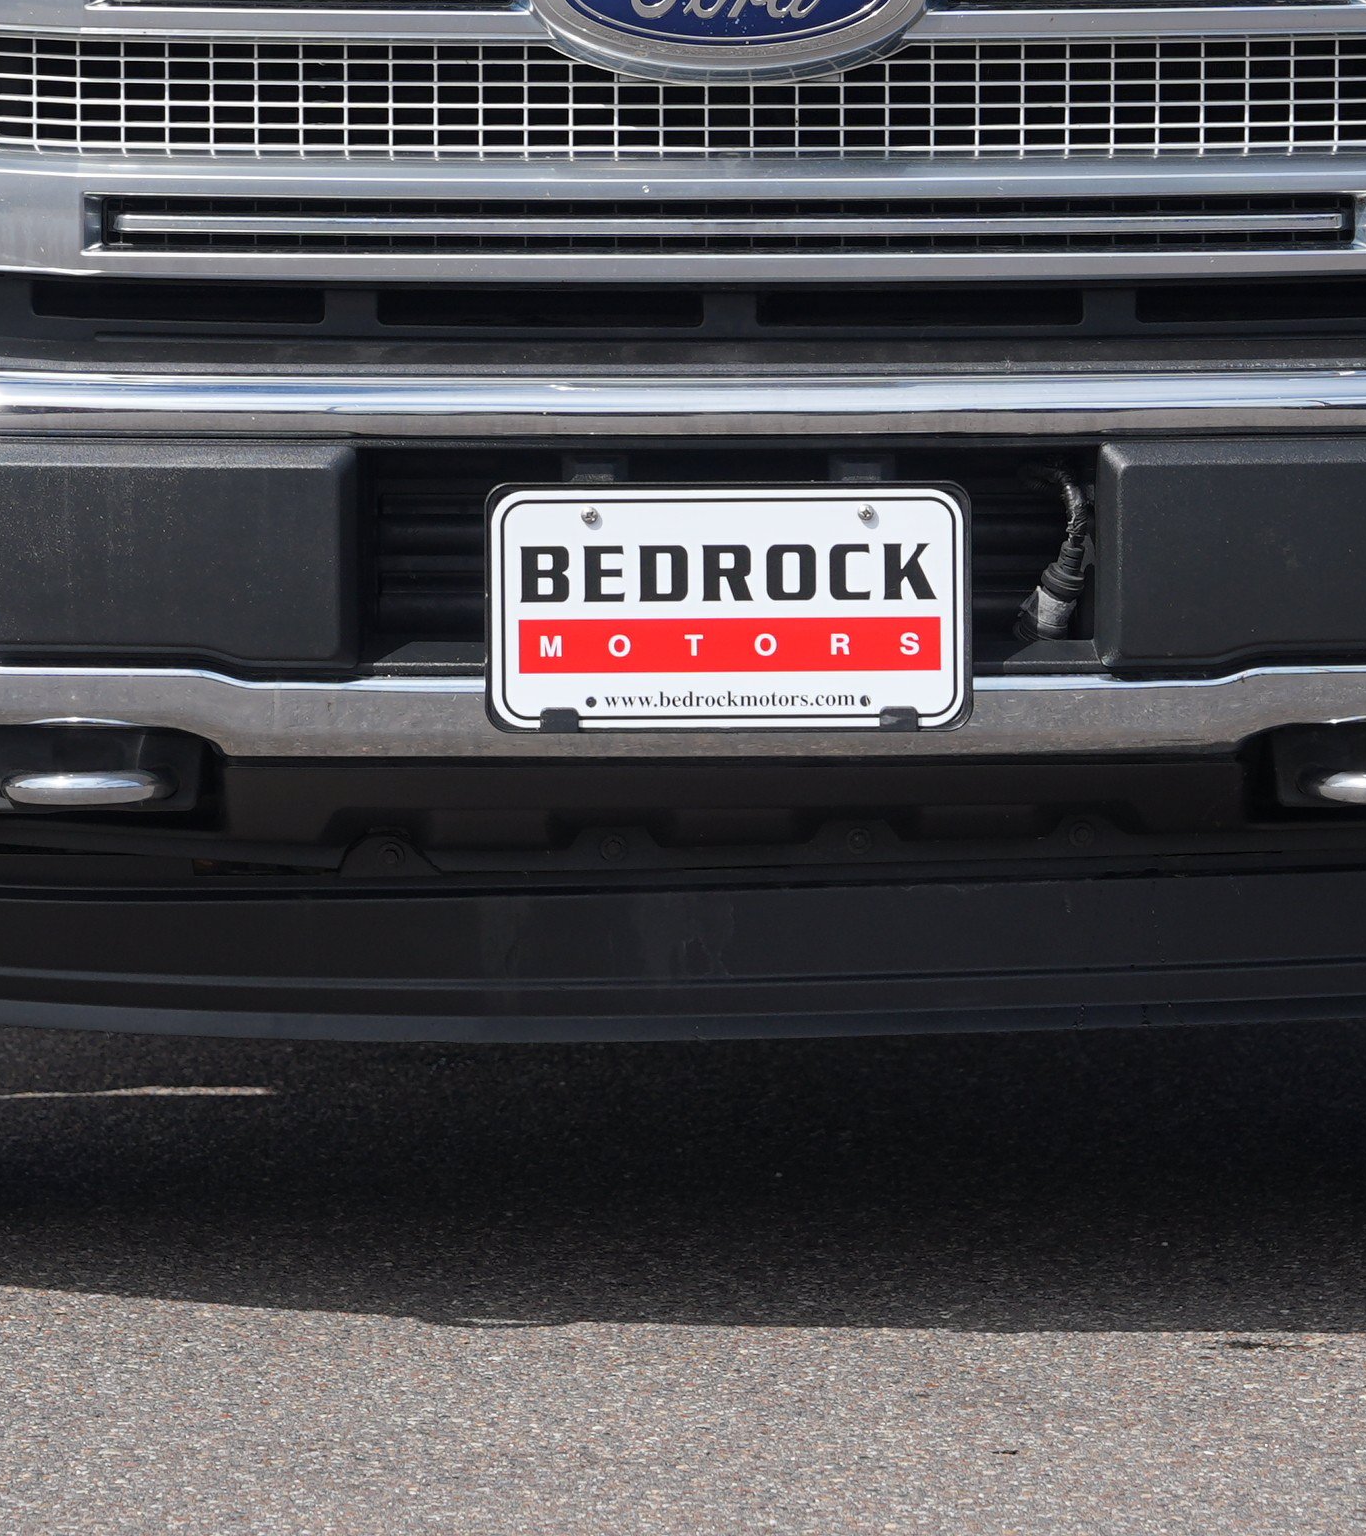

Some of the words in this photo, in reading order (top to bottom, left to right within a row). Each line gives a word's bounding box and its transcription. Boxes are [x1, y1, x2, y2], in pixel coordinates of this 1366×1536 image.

[519, 543, 937, 603] BEDROCK
[539, 631, 921, 658] MOTORS
[604, 690, 856, 709] www.bedrockmotors.com
